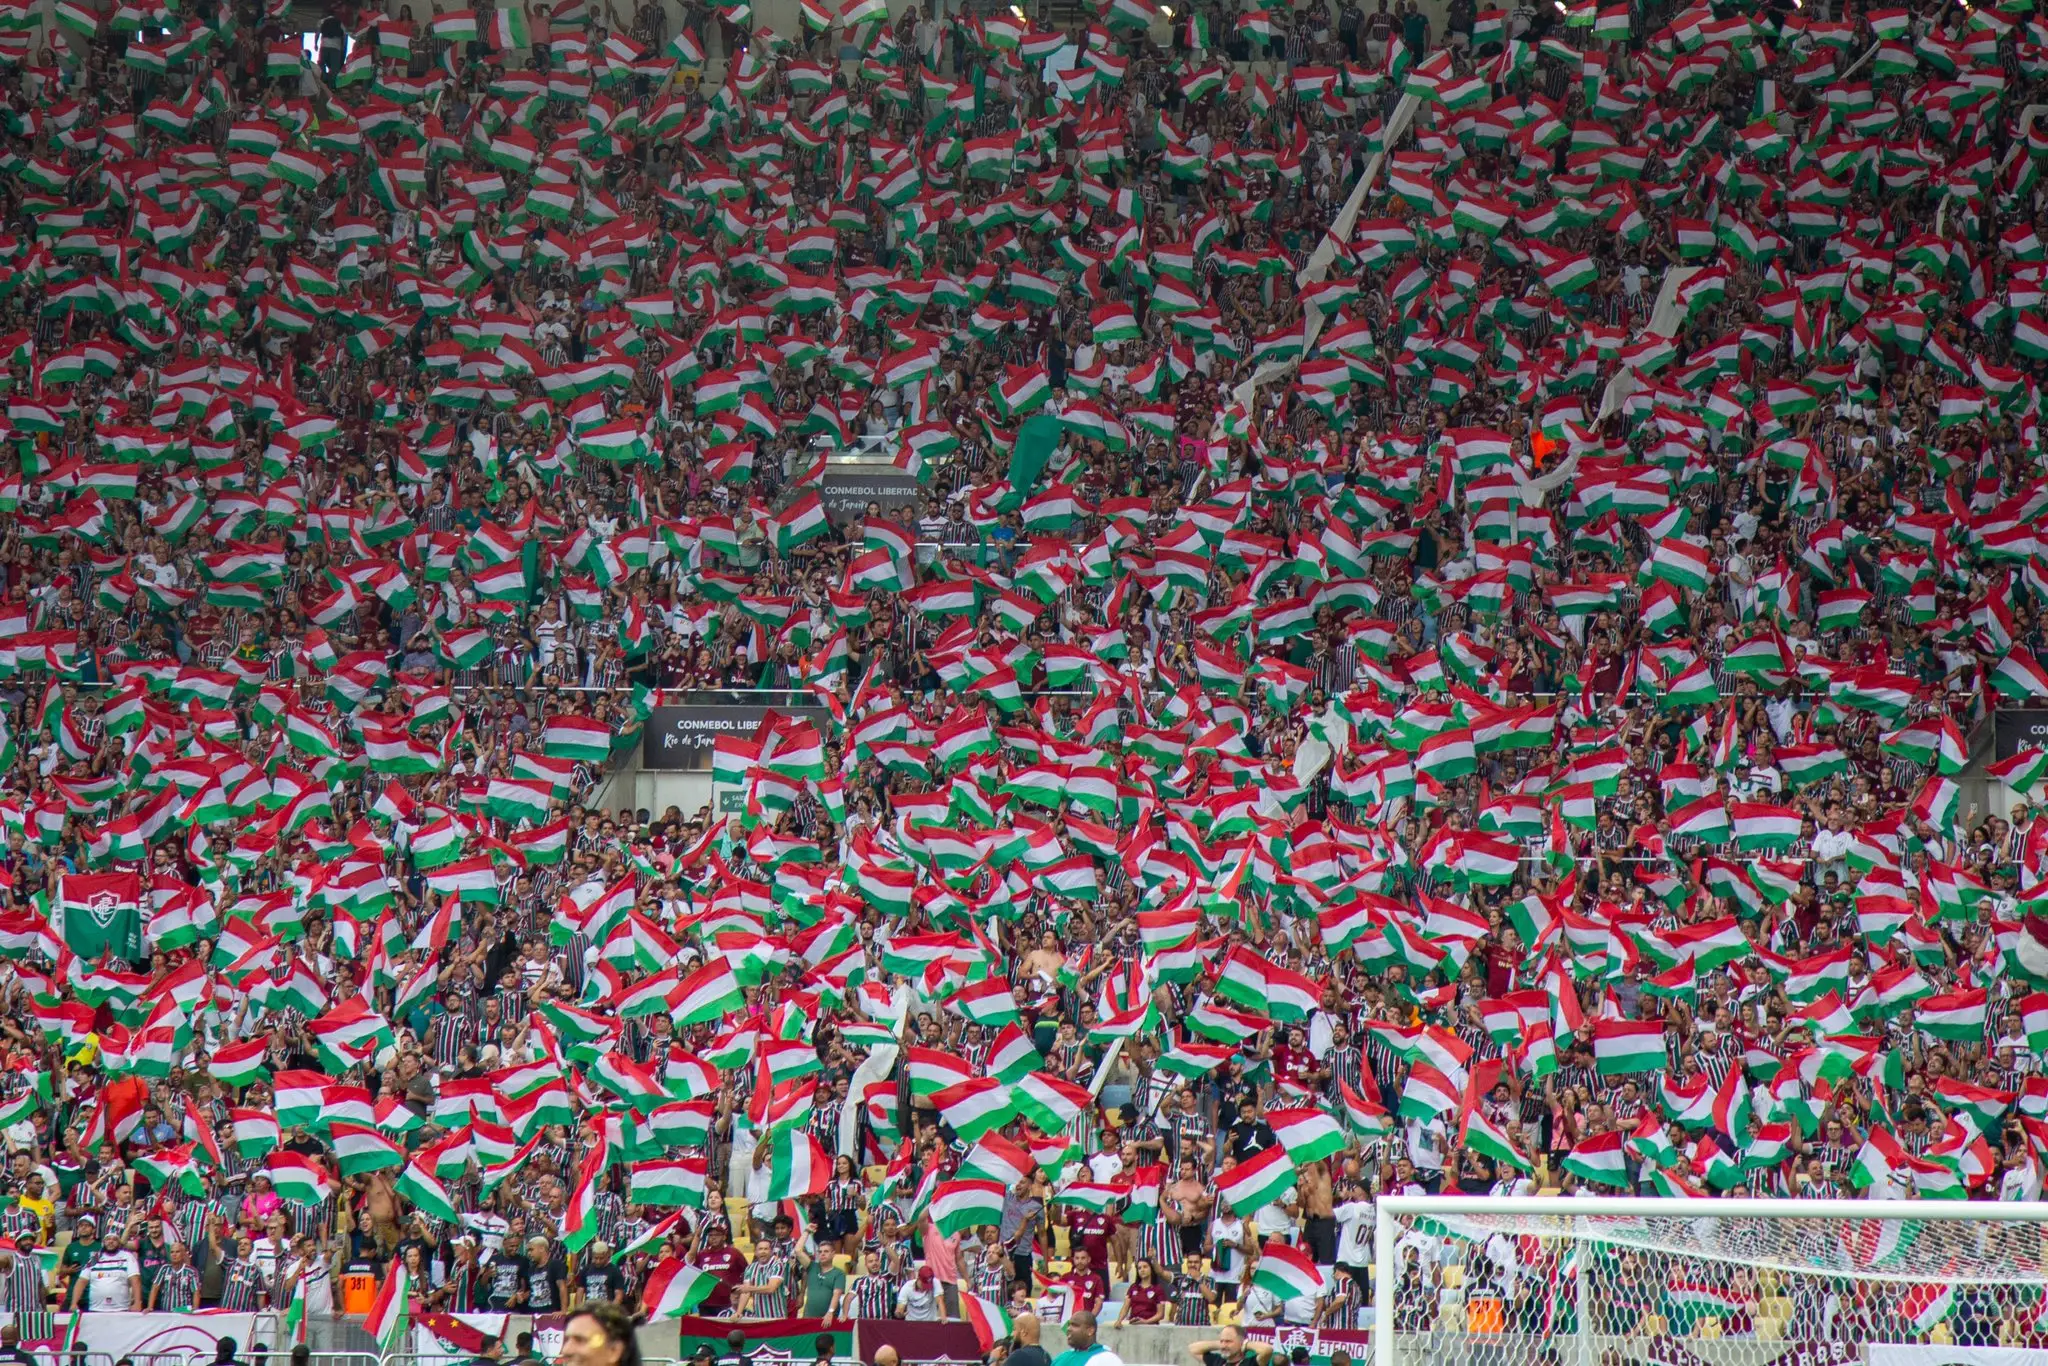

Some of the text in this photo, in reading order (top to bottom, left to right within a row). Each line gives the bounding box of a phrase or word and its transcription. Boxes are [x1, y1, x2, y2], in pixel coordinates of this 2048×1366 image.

[825, 487, 876, 495] CONMEBOL
[677, 720, 762, 730] CONMEBOL LIBE
[664, 732, 679, 748] Rio
[682, 734, 692, 746] de
